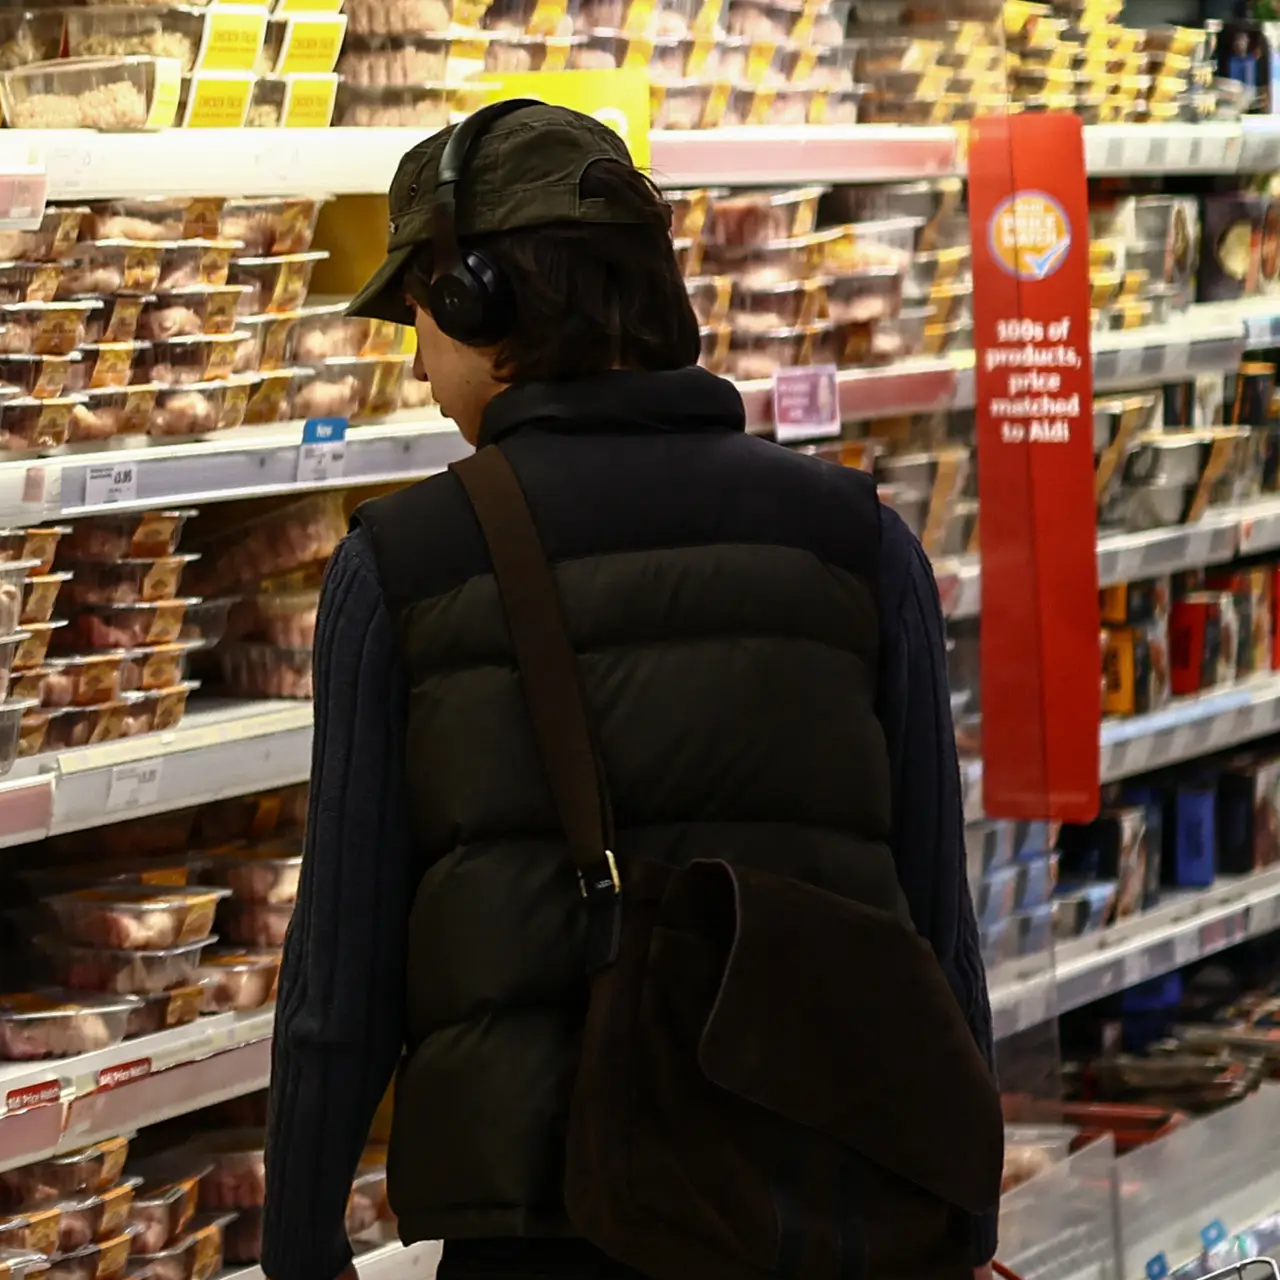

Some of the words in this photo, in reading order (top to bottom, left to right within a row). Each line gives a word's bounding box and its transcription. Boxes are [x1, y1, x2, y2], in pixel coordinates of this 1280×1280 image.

[996, 318, 1044, 342] 100s
[1048, 315, 1071, 341] of
[985, 343, 1081, 371] products,
[1008, 368, 1061, 395] price
[989, 392, 1079, 418] matched
[1001, 421, 1026, 443] to
[1029, 419, 1069, 443] Aldi
